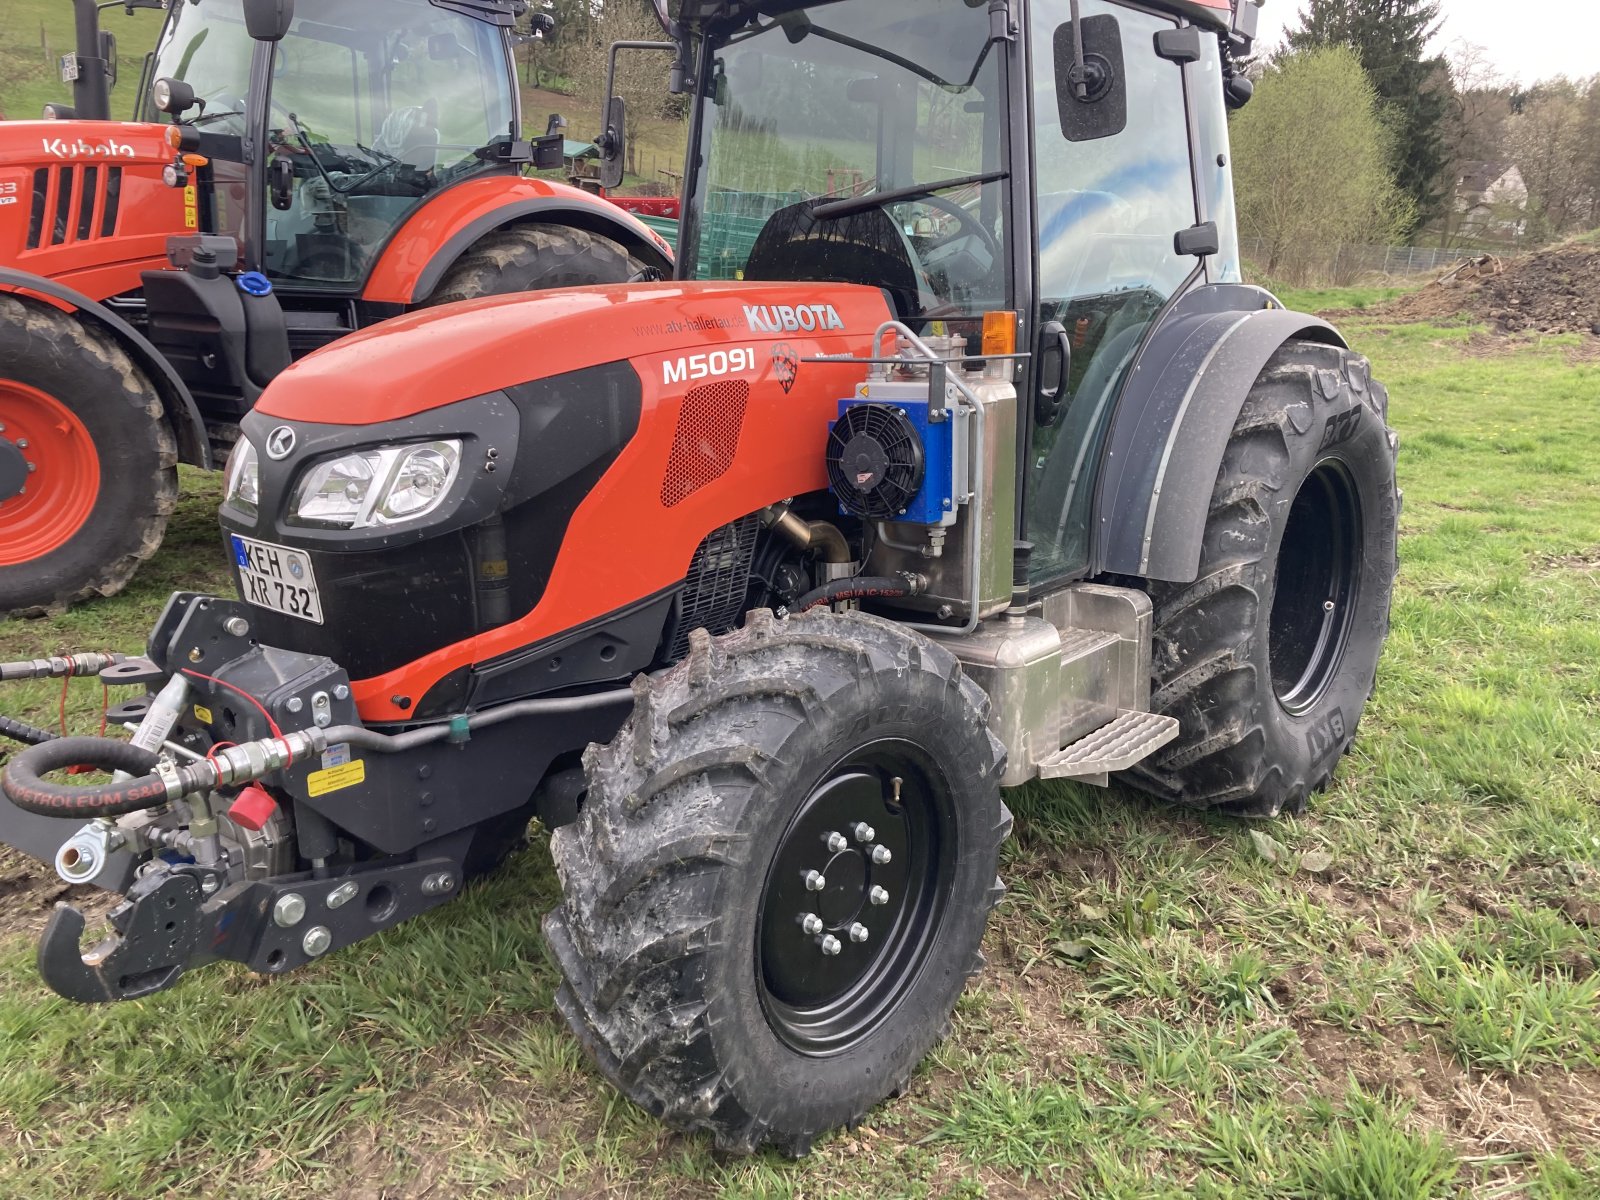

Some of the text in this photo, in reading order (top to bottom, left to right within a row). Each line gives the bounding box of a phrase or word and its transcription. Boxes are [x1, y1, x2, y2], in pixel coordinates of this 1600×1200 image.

[42, 138, 135, 158] Kubota
[632, 315, 745, 337] www.atv-hallertau.de
[742, 304, 845, 333] KUBOTA
[662, 347, 755, 385] M5091
[243, 542, 283, 580] KEH
[246, 572, 314, 618] XR 732
[1305, 705, 1345, 770] BKT
[16, 781, 166, 809] PETROLEUM S&D
